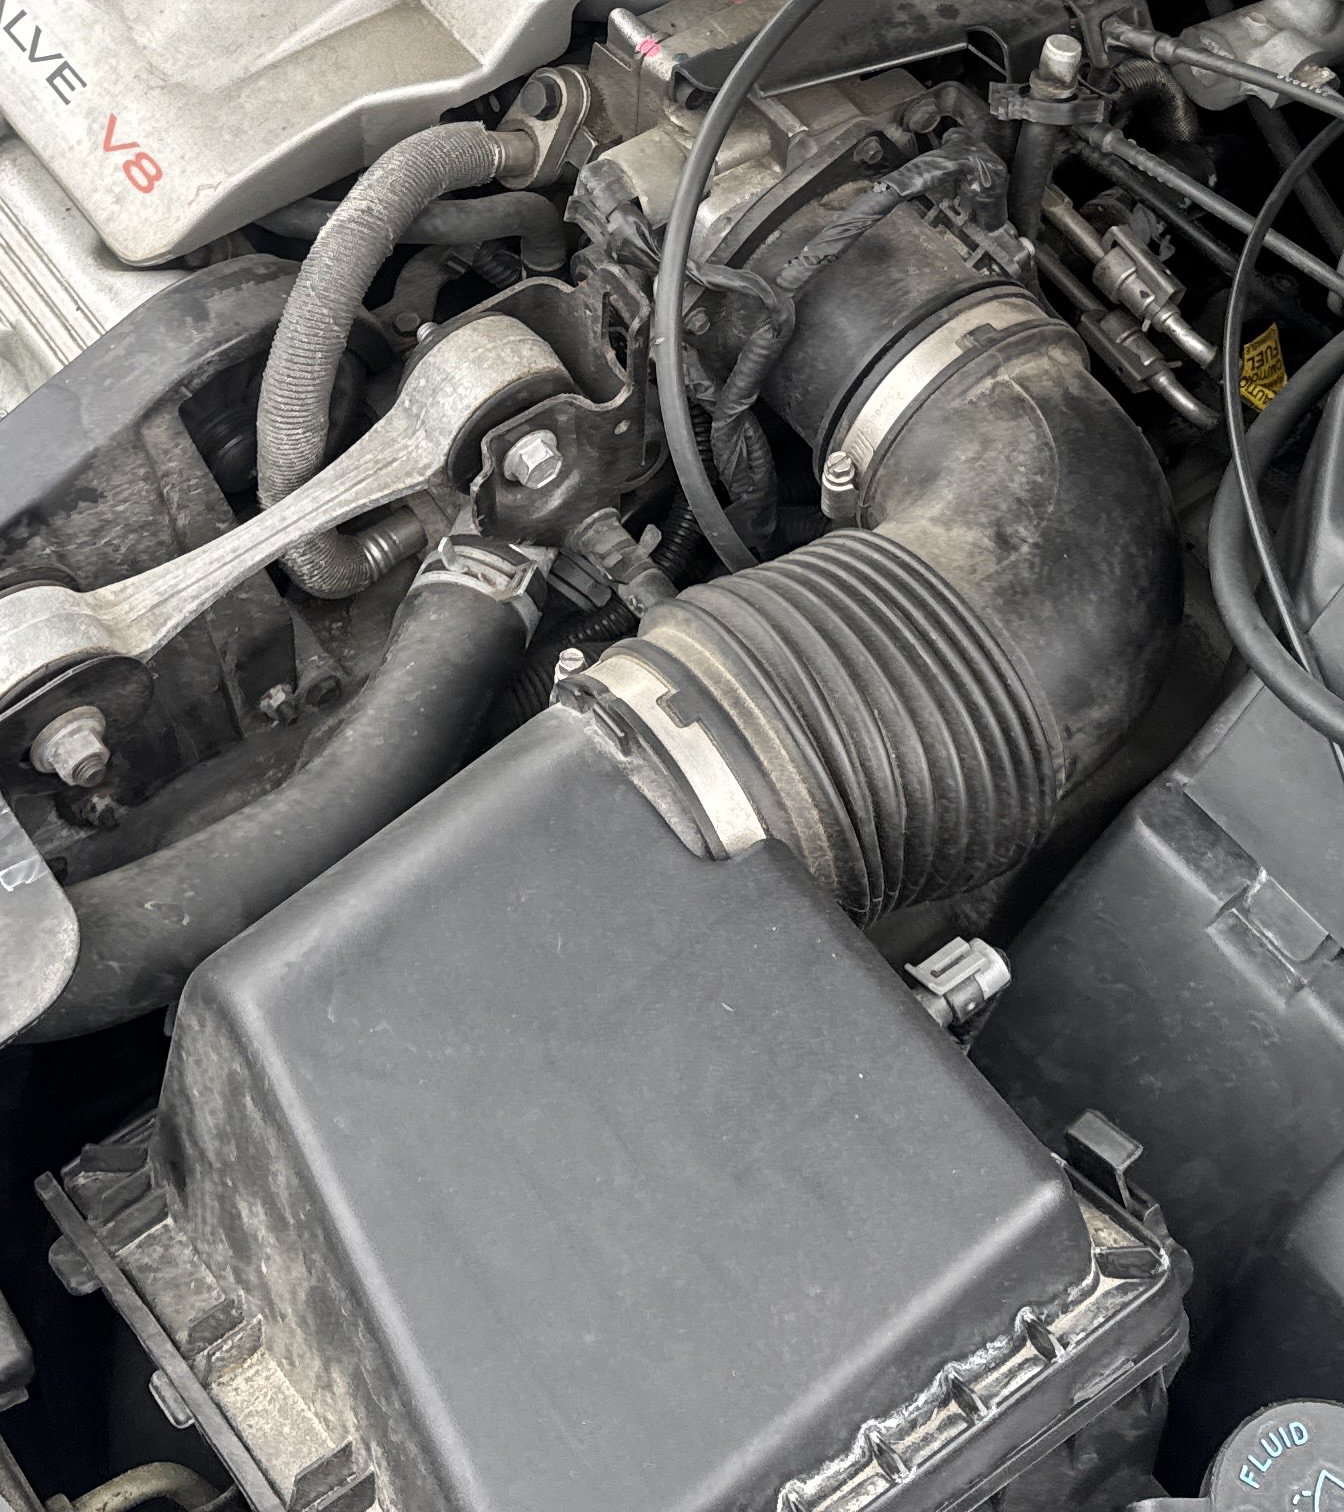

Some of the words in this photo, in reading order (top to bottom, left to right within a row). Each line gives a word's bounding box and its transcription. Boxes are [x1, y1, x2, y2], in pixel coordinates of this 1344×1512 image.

[102, 114, 164, 194] V8
[1245, 344, 1279, 371] FUEL
[1239, 1421, 1309, 1489] FLUID
